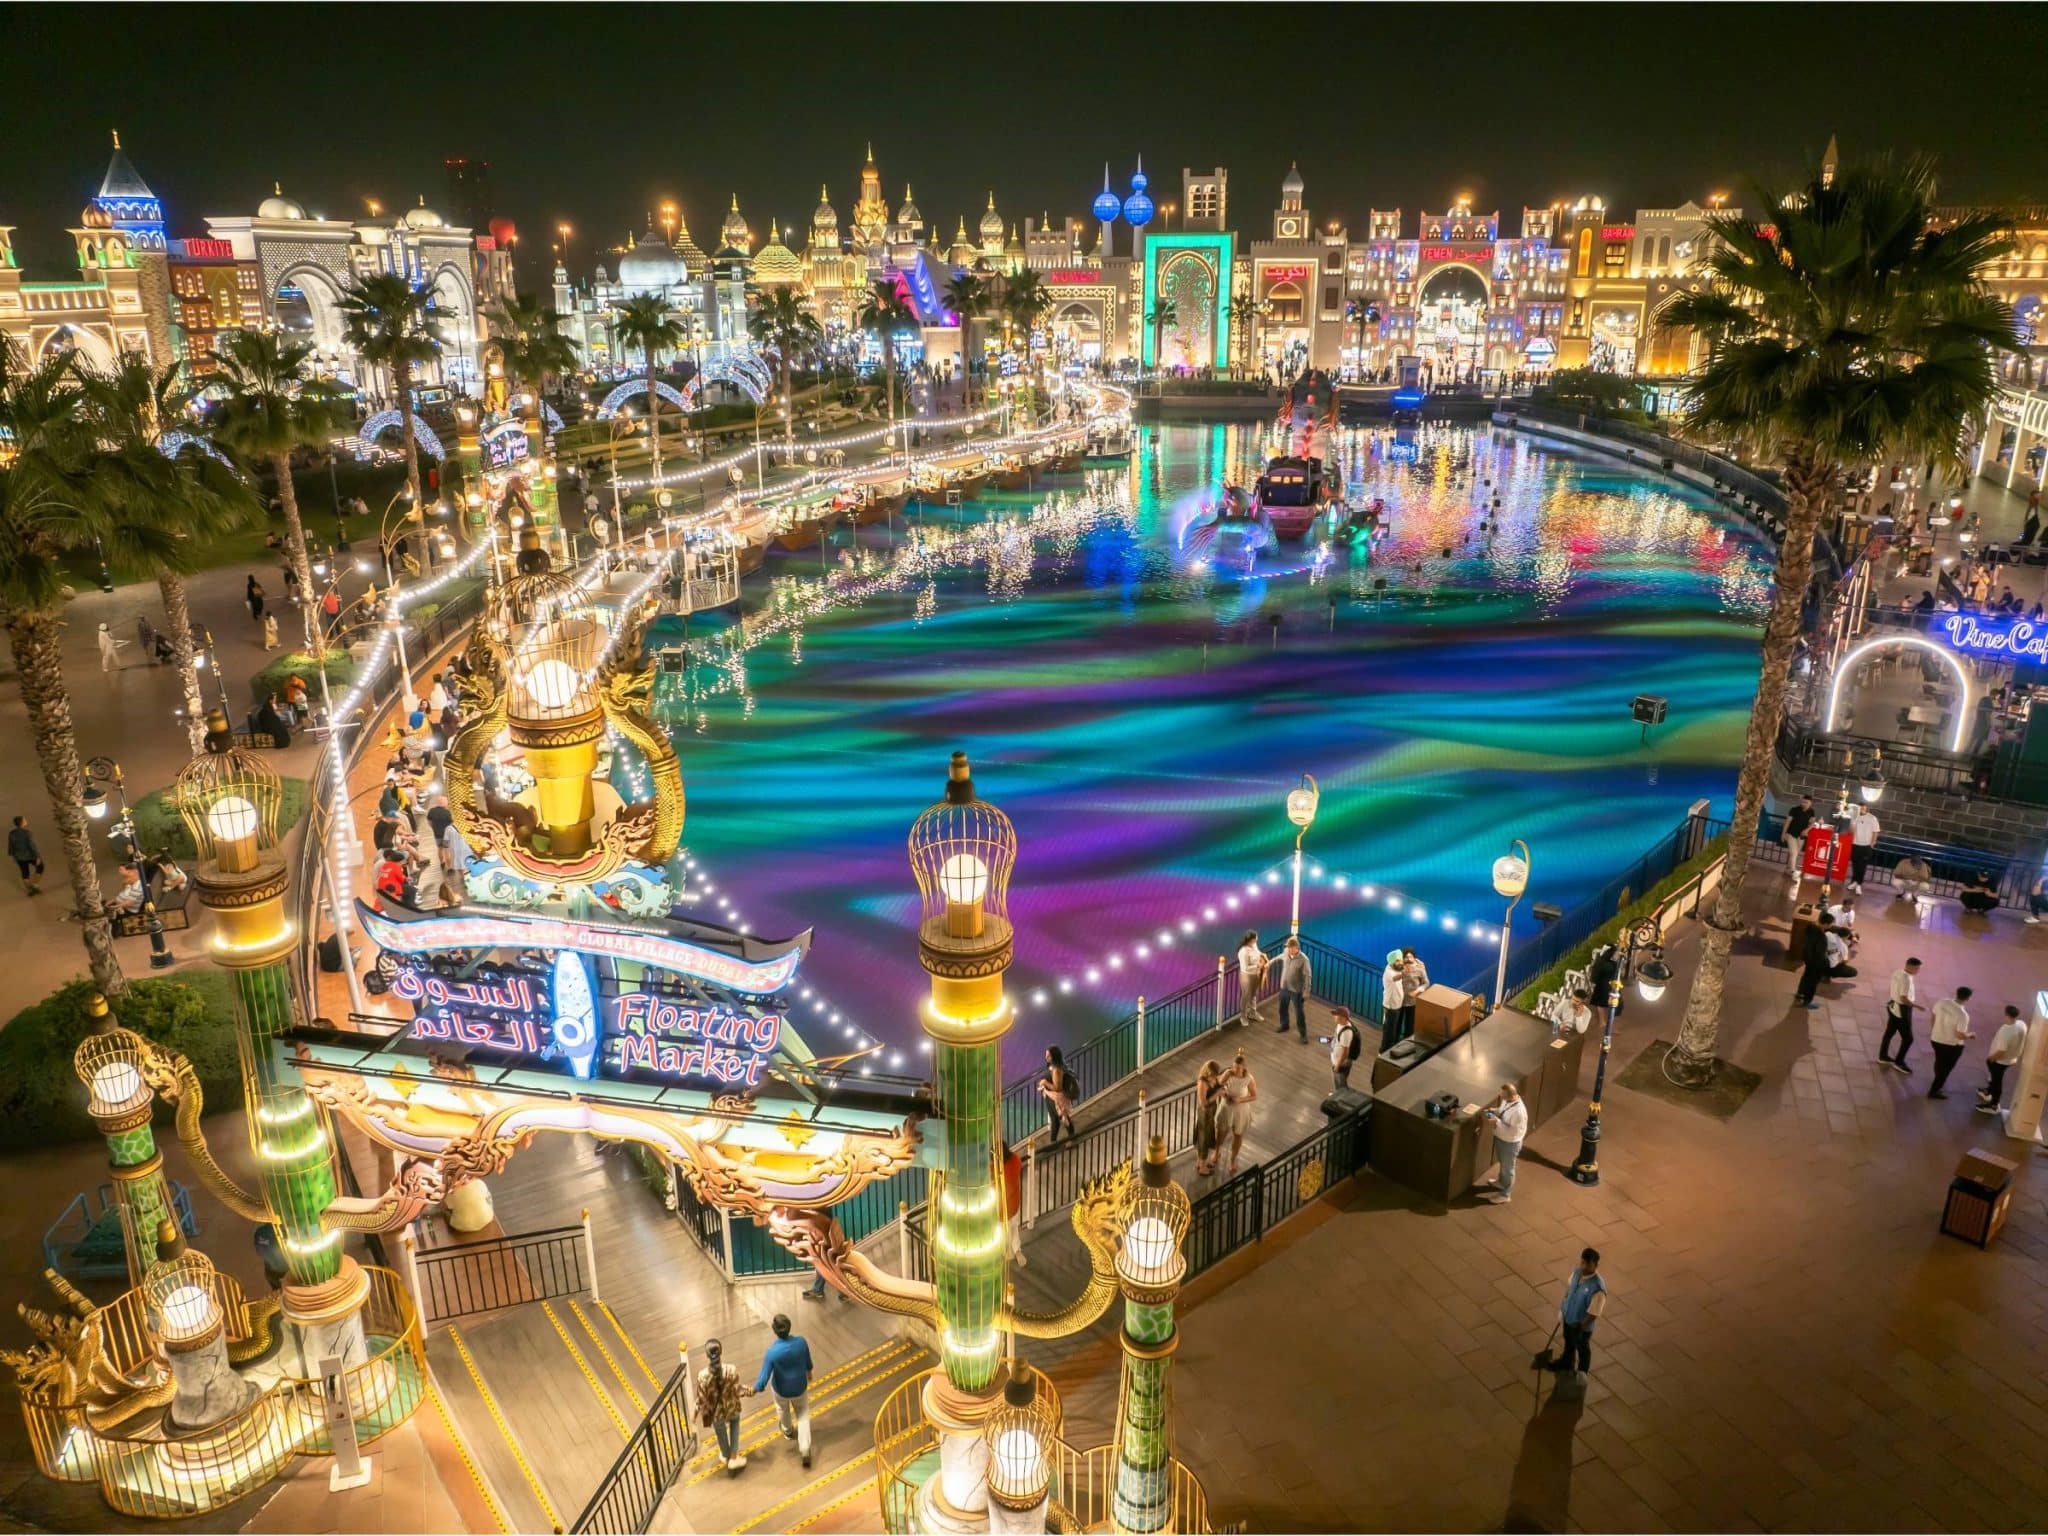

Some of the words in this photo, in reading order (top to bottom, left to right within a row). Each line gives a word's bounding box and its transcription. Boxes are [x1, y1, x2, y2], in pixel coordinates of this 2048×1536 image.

[1265, 264, 1309, 281] الكويت
[1421, 247, 1453, 260] YEMEN
[1945, 615, 2008, 649] Vine
[579, 933, 632, 952] GLOBAL
[393, 967, 532, 1012] السوق
[411, 1008, 537, 1052] العائم
[612, 994, 780, 1052] Floating
[620, 1033, 767, 1086] Market
